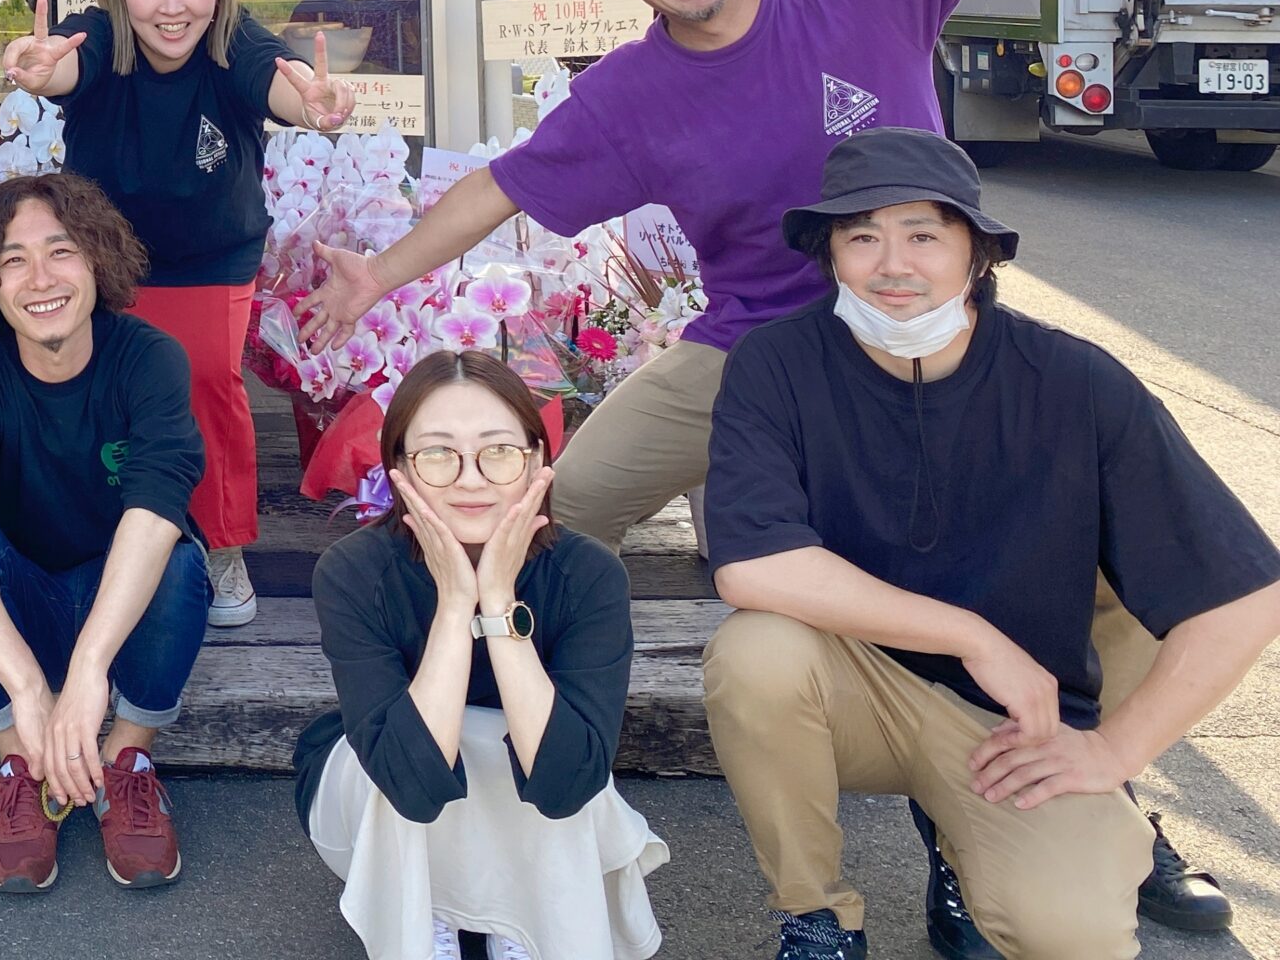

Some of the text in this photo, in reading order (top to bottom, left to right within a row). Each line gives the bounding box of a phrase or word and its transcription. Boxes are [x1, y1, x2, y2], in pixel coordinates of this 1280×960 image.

[533, 0, 604, 22] 祝 10周年
[540, 18, 639, 37] アールダブルエス
[524, 39, 548, 56] 代表
[563, 36, 589, 54] 鈴木
[1217, 73, 1265, 91] 19-03
